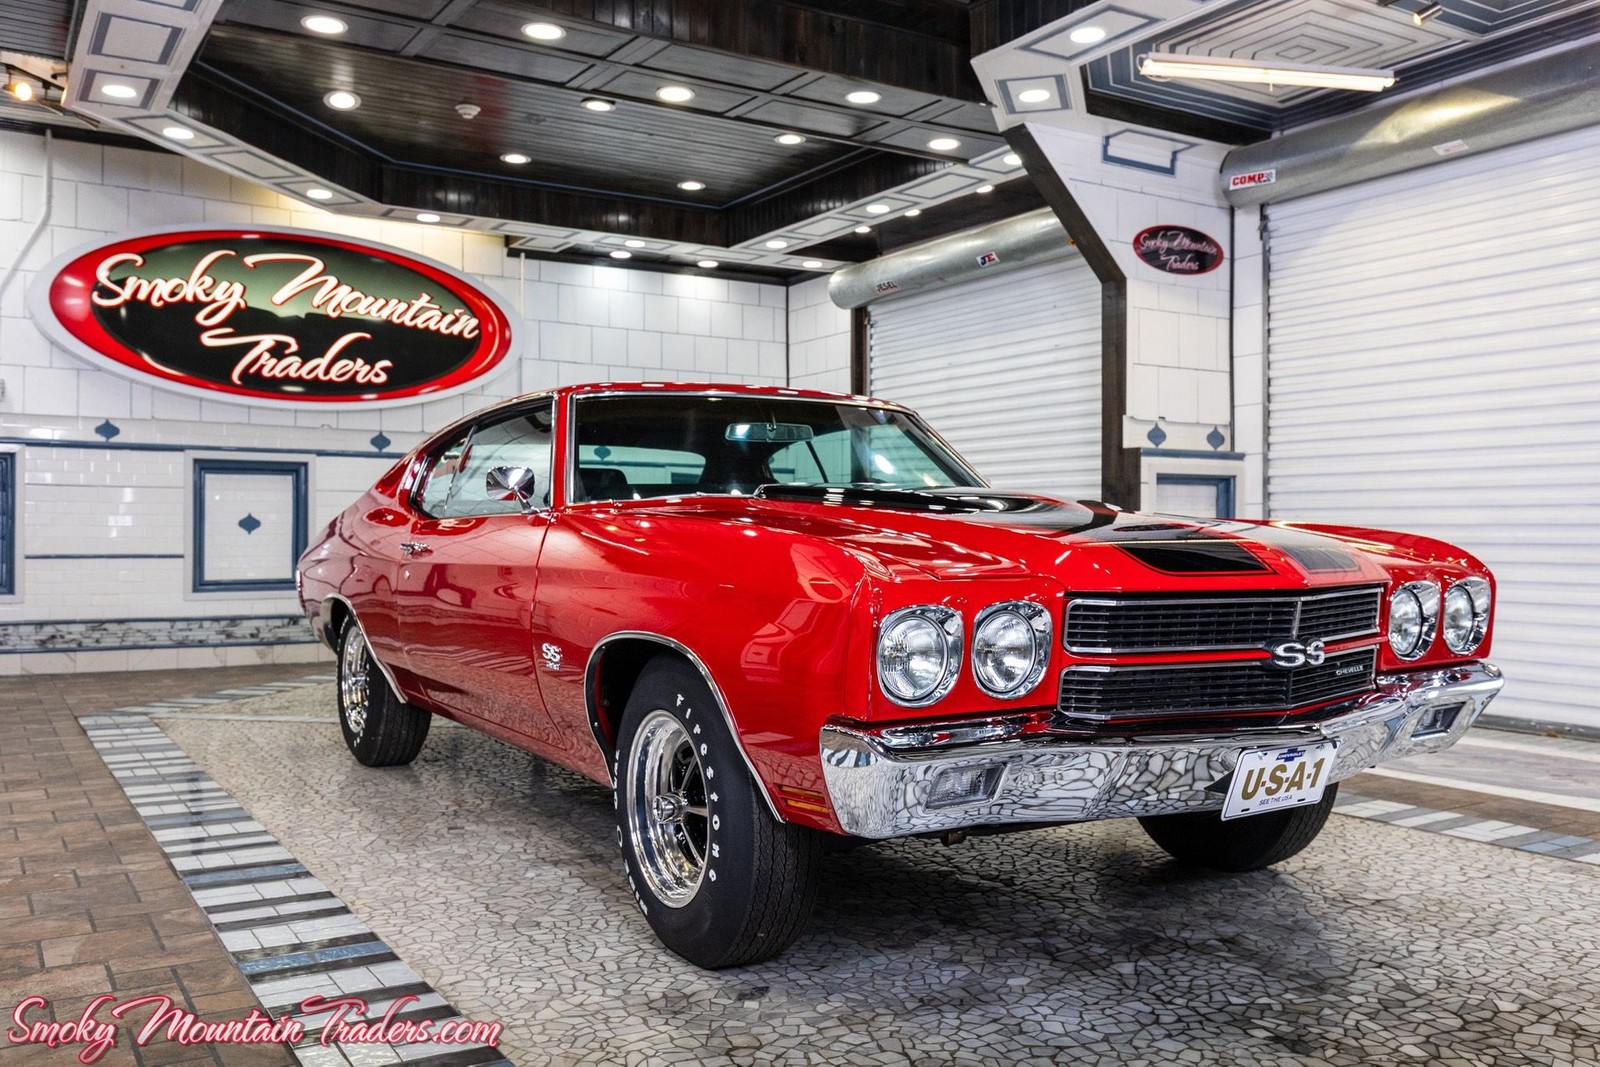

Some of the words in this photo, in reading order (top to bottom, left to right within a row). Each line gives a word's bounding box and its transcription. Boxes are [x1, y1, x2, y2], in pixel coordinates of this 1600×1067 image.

[1232, 172, 1265, 186] COMP
[1140, 230, 1169, 254] Smoky
[1167, 231, 1217, 254] Mountain
[1160, 253, 1200, 271] Traders
[91, 249, 246, 326] Smoky
[243, 252, 481, 340] Mountain
[199, 327, 394, 386] Traders
[542, 643, 561, 662] SS
[1275, 640, 1325, 667] SS
[1336, 665, 1364, 675] CHEVELLE
